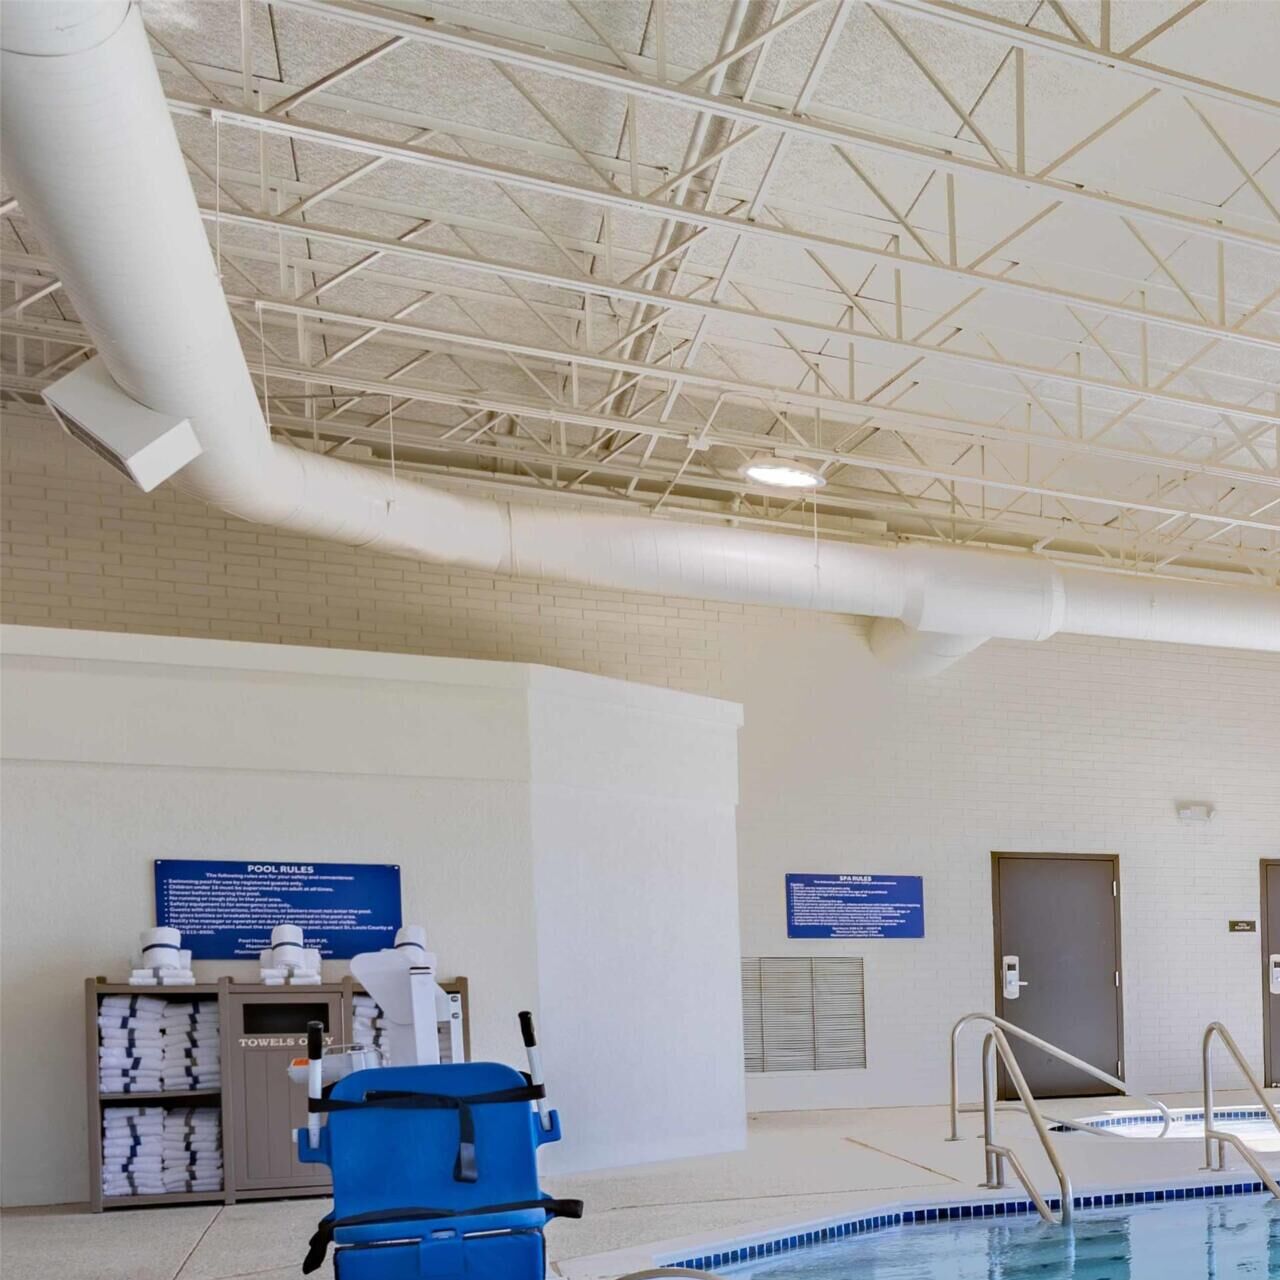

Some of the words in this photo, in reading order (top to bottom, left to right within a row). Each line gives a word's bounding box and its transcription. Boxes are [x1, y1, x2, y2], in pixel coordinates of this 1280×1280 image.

[248, 865, 278, 873] POOL
[238, 1037, 295, 1048] TOWELS
[298, 1036, 334, 1047] OY
